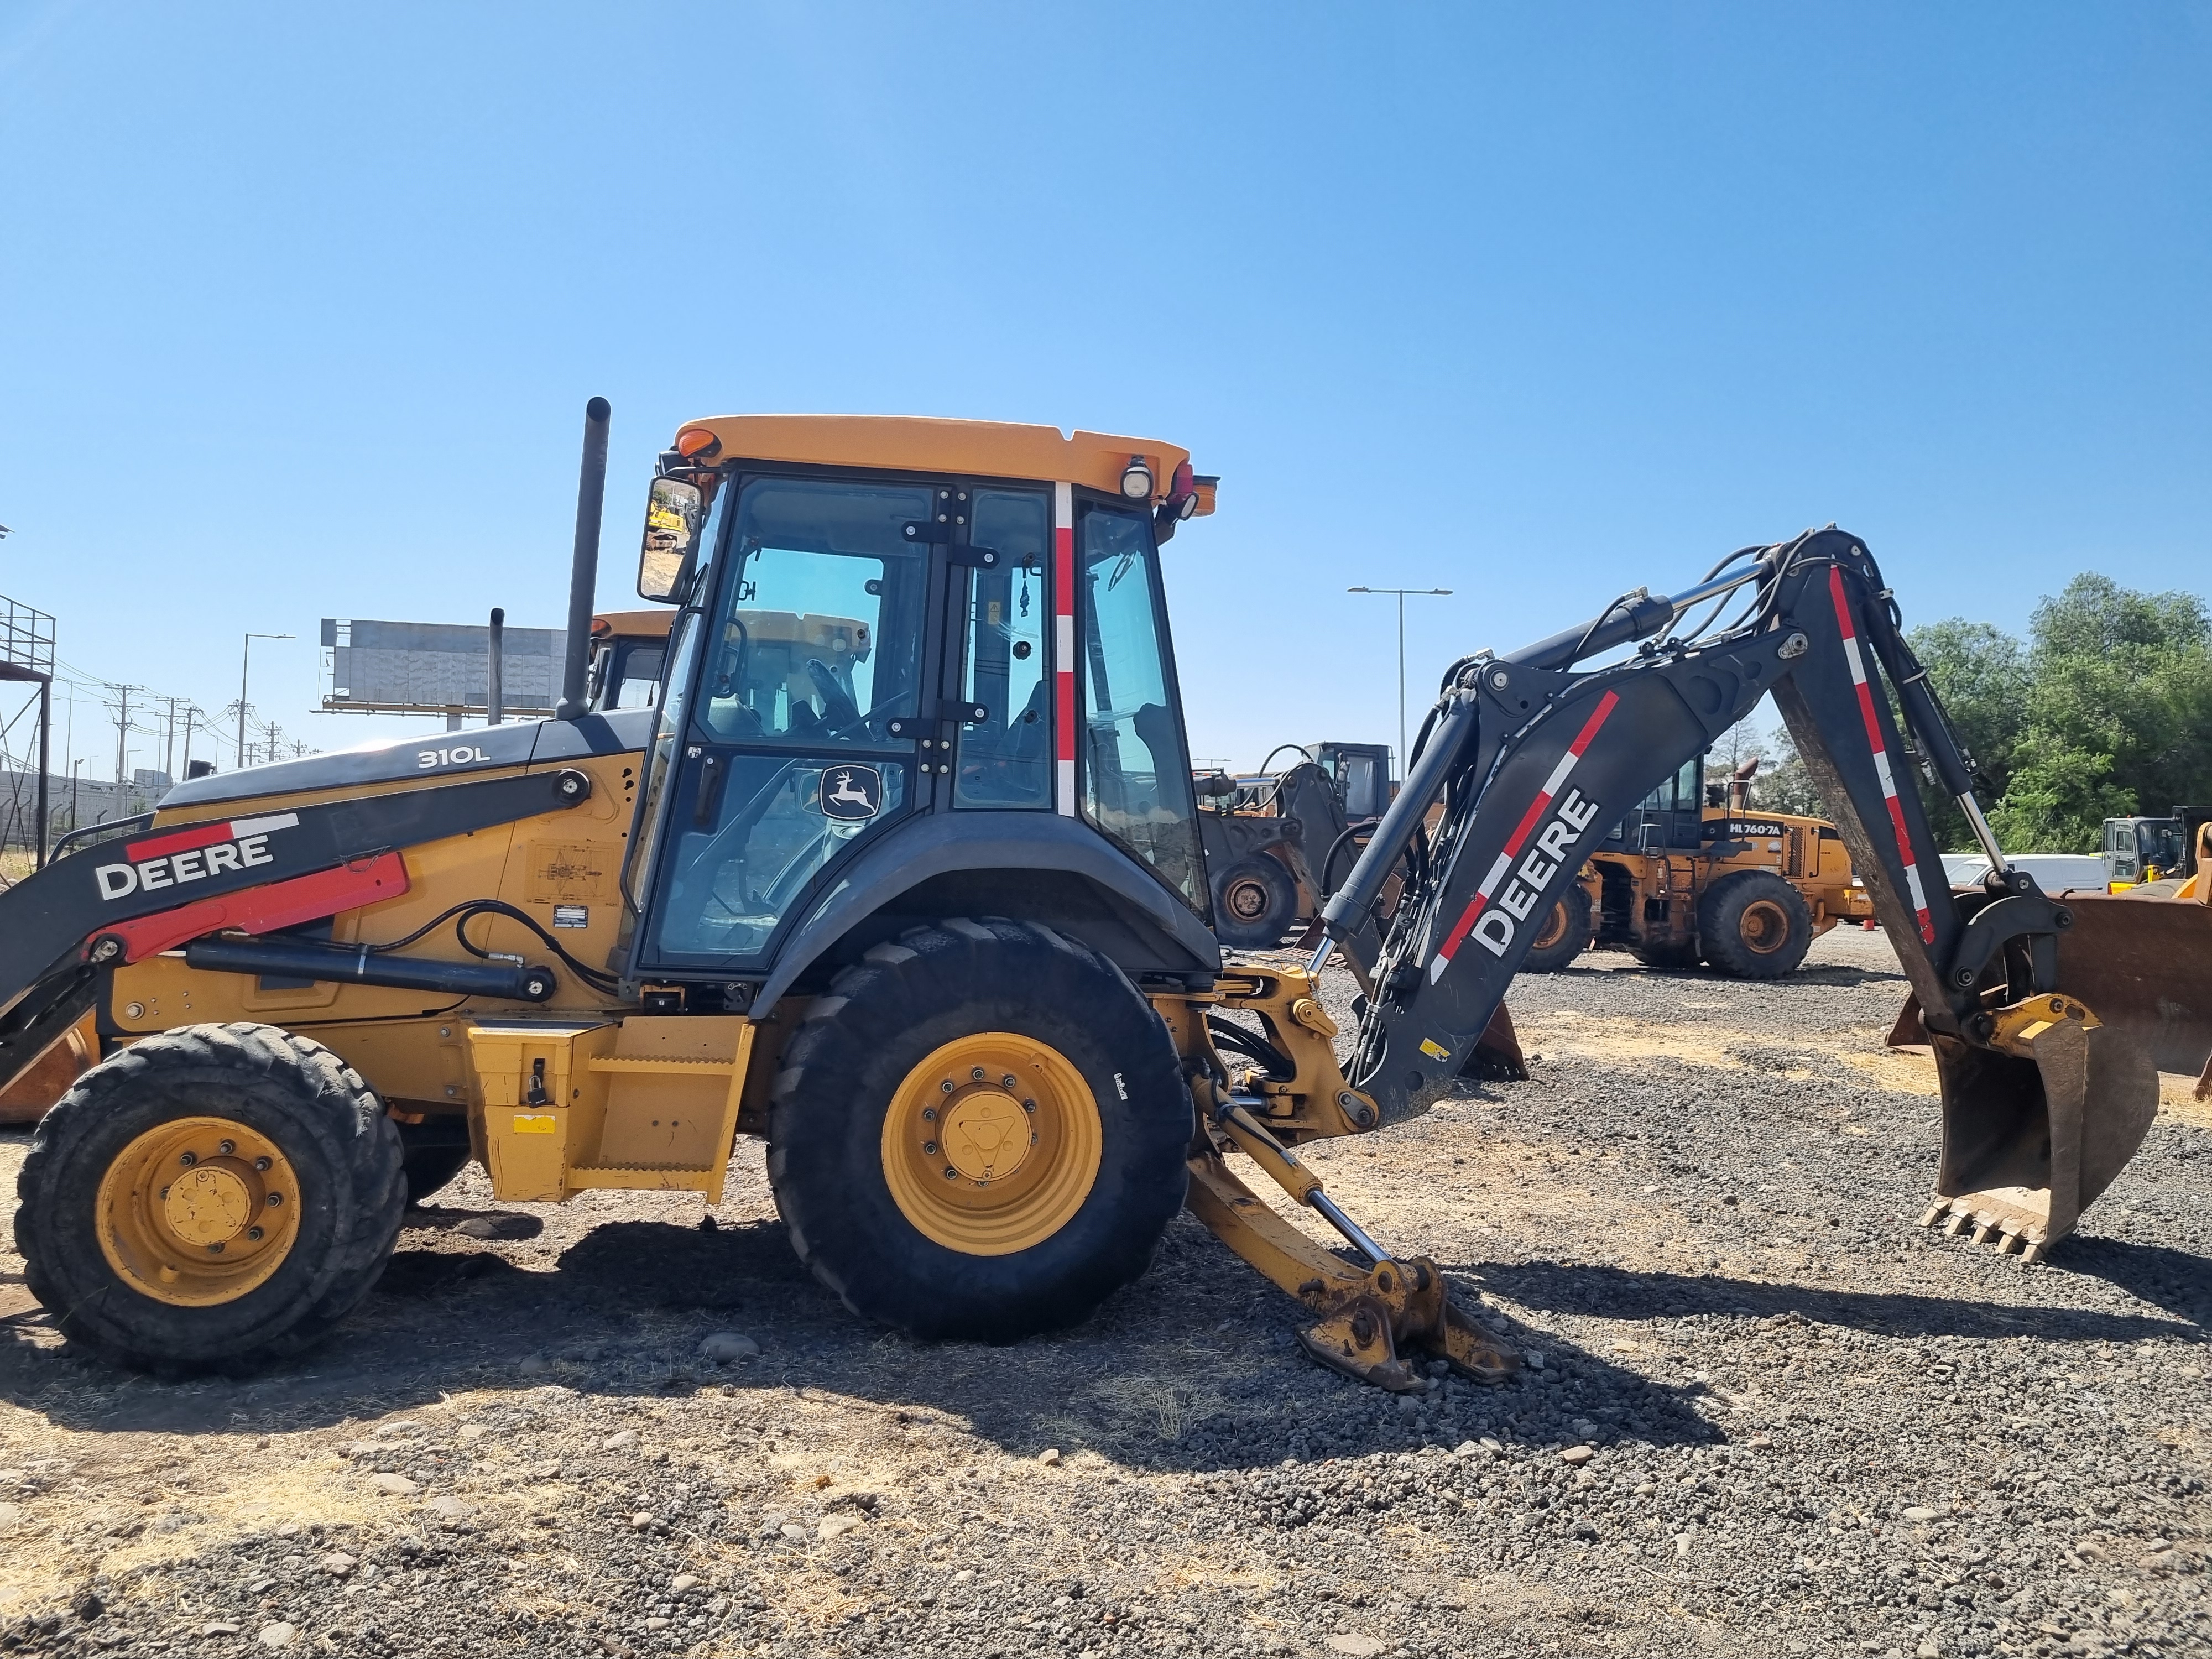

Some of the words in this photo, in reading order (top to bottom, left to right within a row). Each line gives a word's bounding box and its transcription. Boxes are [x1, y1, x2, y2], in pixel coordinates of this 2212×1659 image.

[418, 747, 491, 768] 310L
[1730, 823, 1780, 835] HL760-7A
[96, 835, 273, 900] DEERE
[1471, 789, 1599, 957] DEERE
